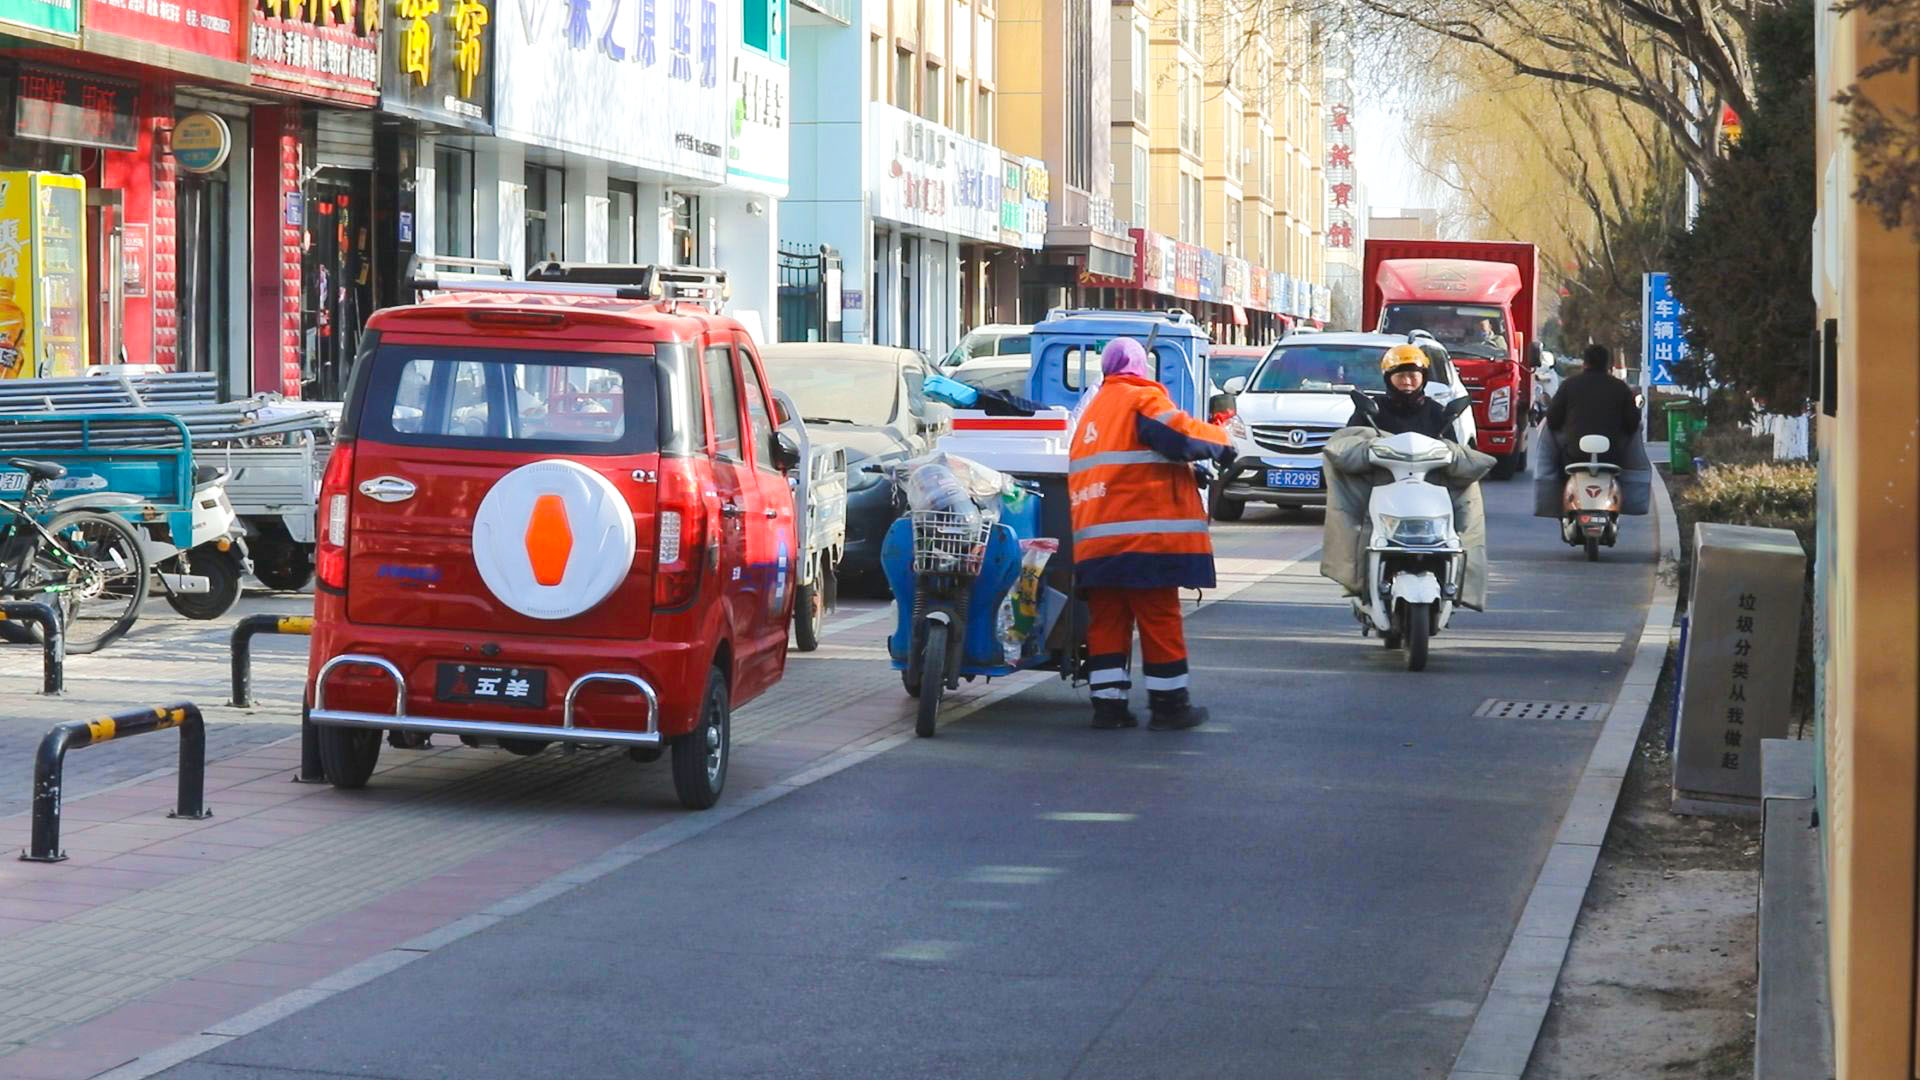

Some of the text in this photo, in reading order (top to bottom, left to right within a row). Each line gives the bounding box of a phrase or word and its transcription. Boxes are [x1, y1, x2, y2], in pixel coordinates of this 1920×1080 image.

[1654, 299, 1674, 382] 车辆出入
[632, 469, 658, 483] Q1
[474, 677, 530, 697] 五羊
[1721, 592, 1757, 771] 垃圾分类从我做起
